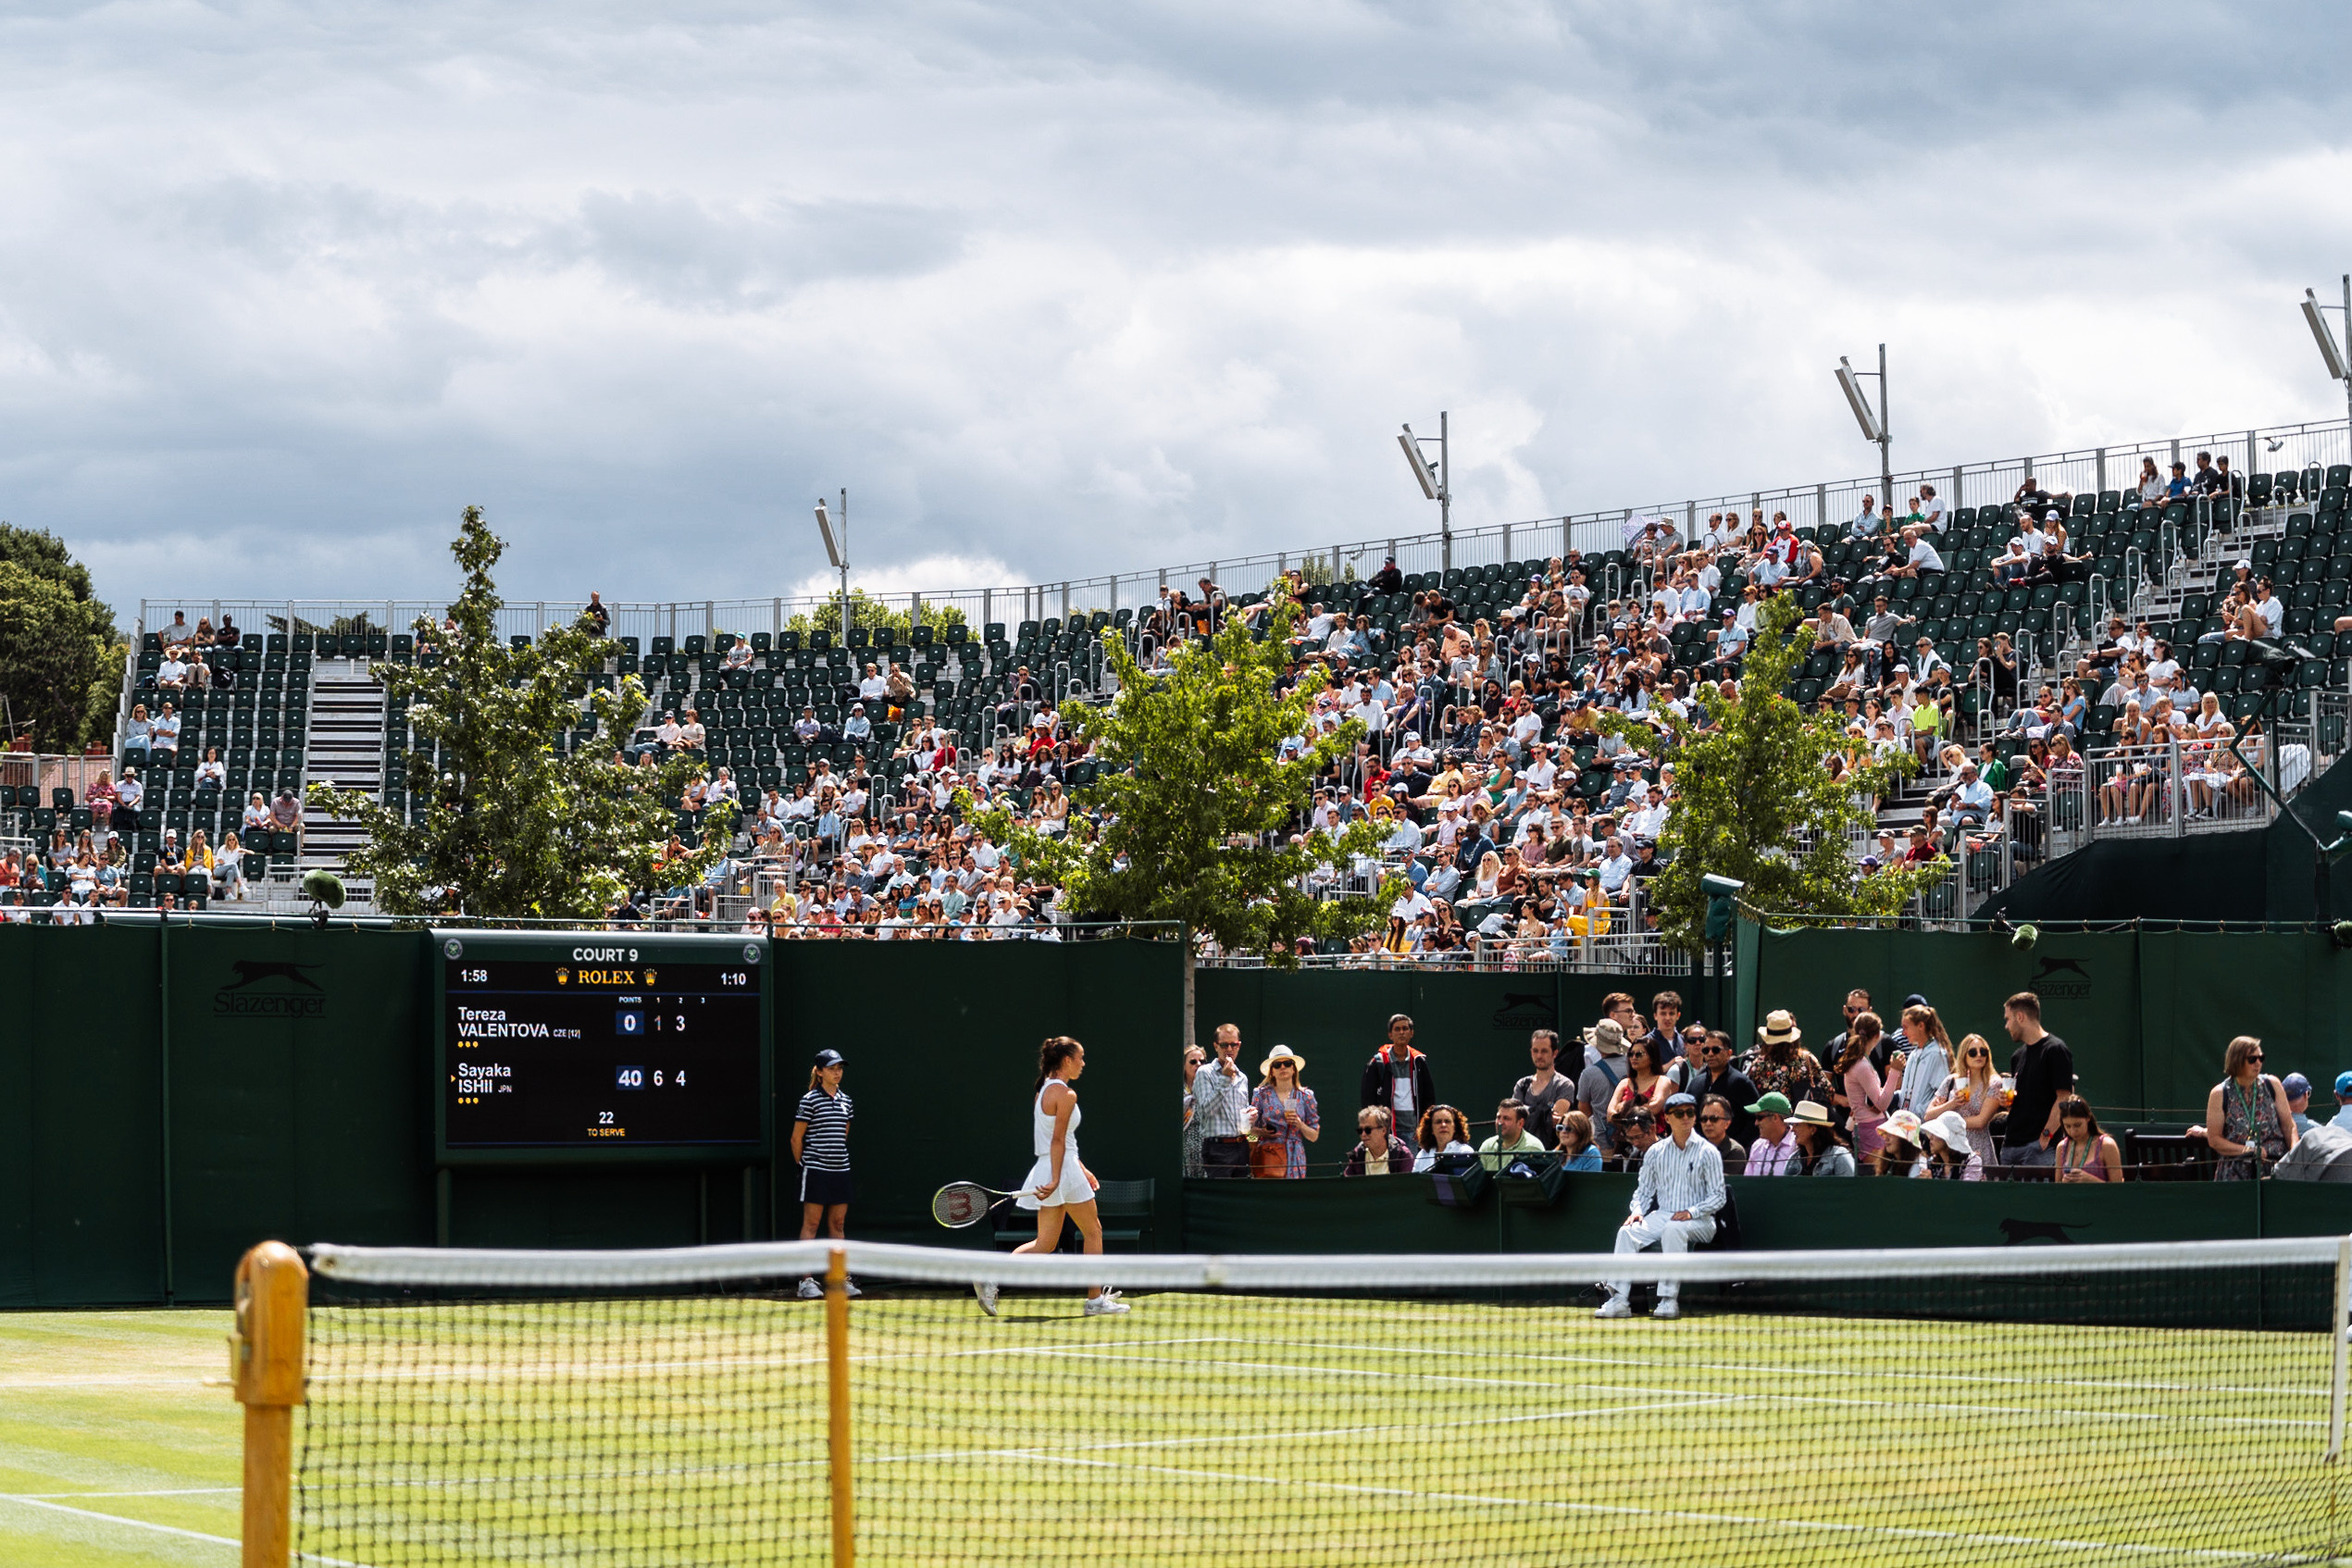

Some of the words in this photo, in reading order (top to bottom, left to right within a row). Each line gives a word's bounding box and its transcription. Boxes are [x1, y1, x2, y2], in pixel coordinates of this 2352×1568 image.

[572, 948, 625, 963] COURT
[628, 949, 639, 962] 9
[461, 969, 488, 982] 1:58
[578, 970, 636, 985] ROLEX
[720, 973, 747, 986] 1:10
[2028, 981, 2092, 1000] Slazenger
[213, 991, 327, 1019] Slazenger
[458, 1006, 506, 1021] Tereza
[457, 1023, 550, 1038] VALENTOVA
[553, 1028, 567, 1038] CZE
[624, 1014, 637, 1032] 0
[653, 1014, 663, 1031] 1
[676, 1014, 686, 1031] 3
[458, 1063, 512, 1080] Sayaka
[618, 1070, 642, 1087] 40
[653, 1070, 664, 1087] 6
[675, 1070, 687, 1087] 4
[458, 1079, 493, 1093] ISHII
[498, 1085, 512, 1093] JPN
[599, 1112, 615, 1124] 22
[587, 1128, 598, 1137] TO
[599, 1128, 626, 1137] SERVE
